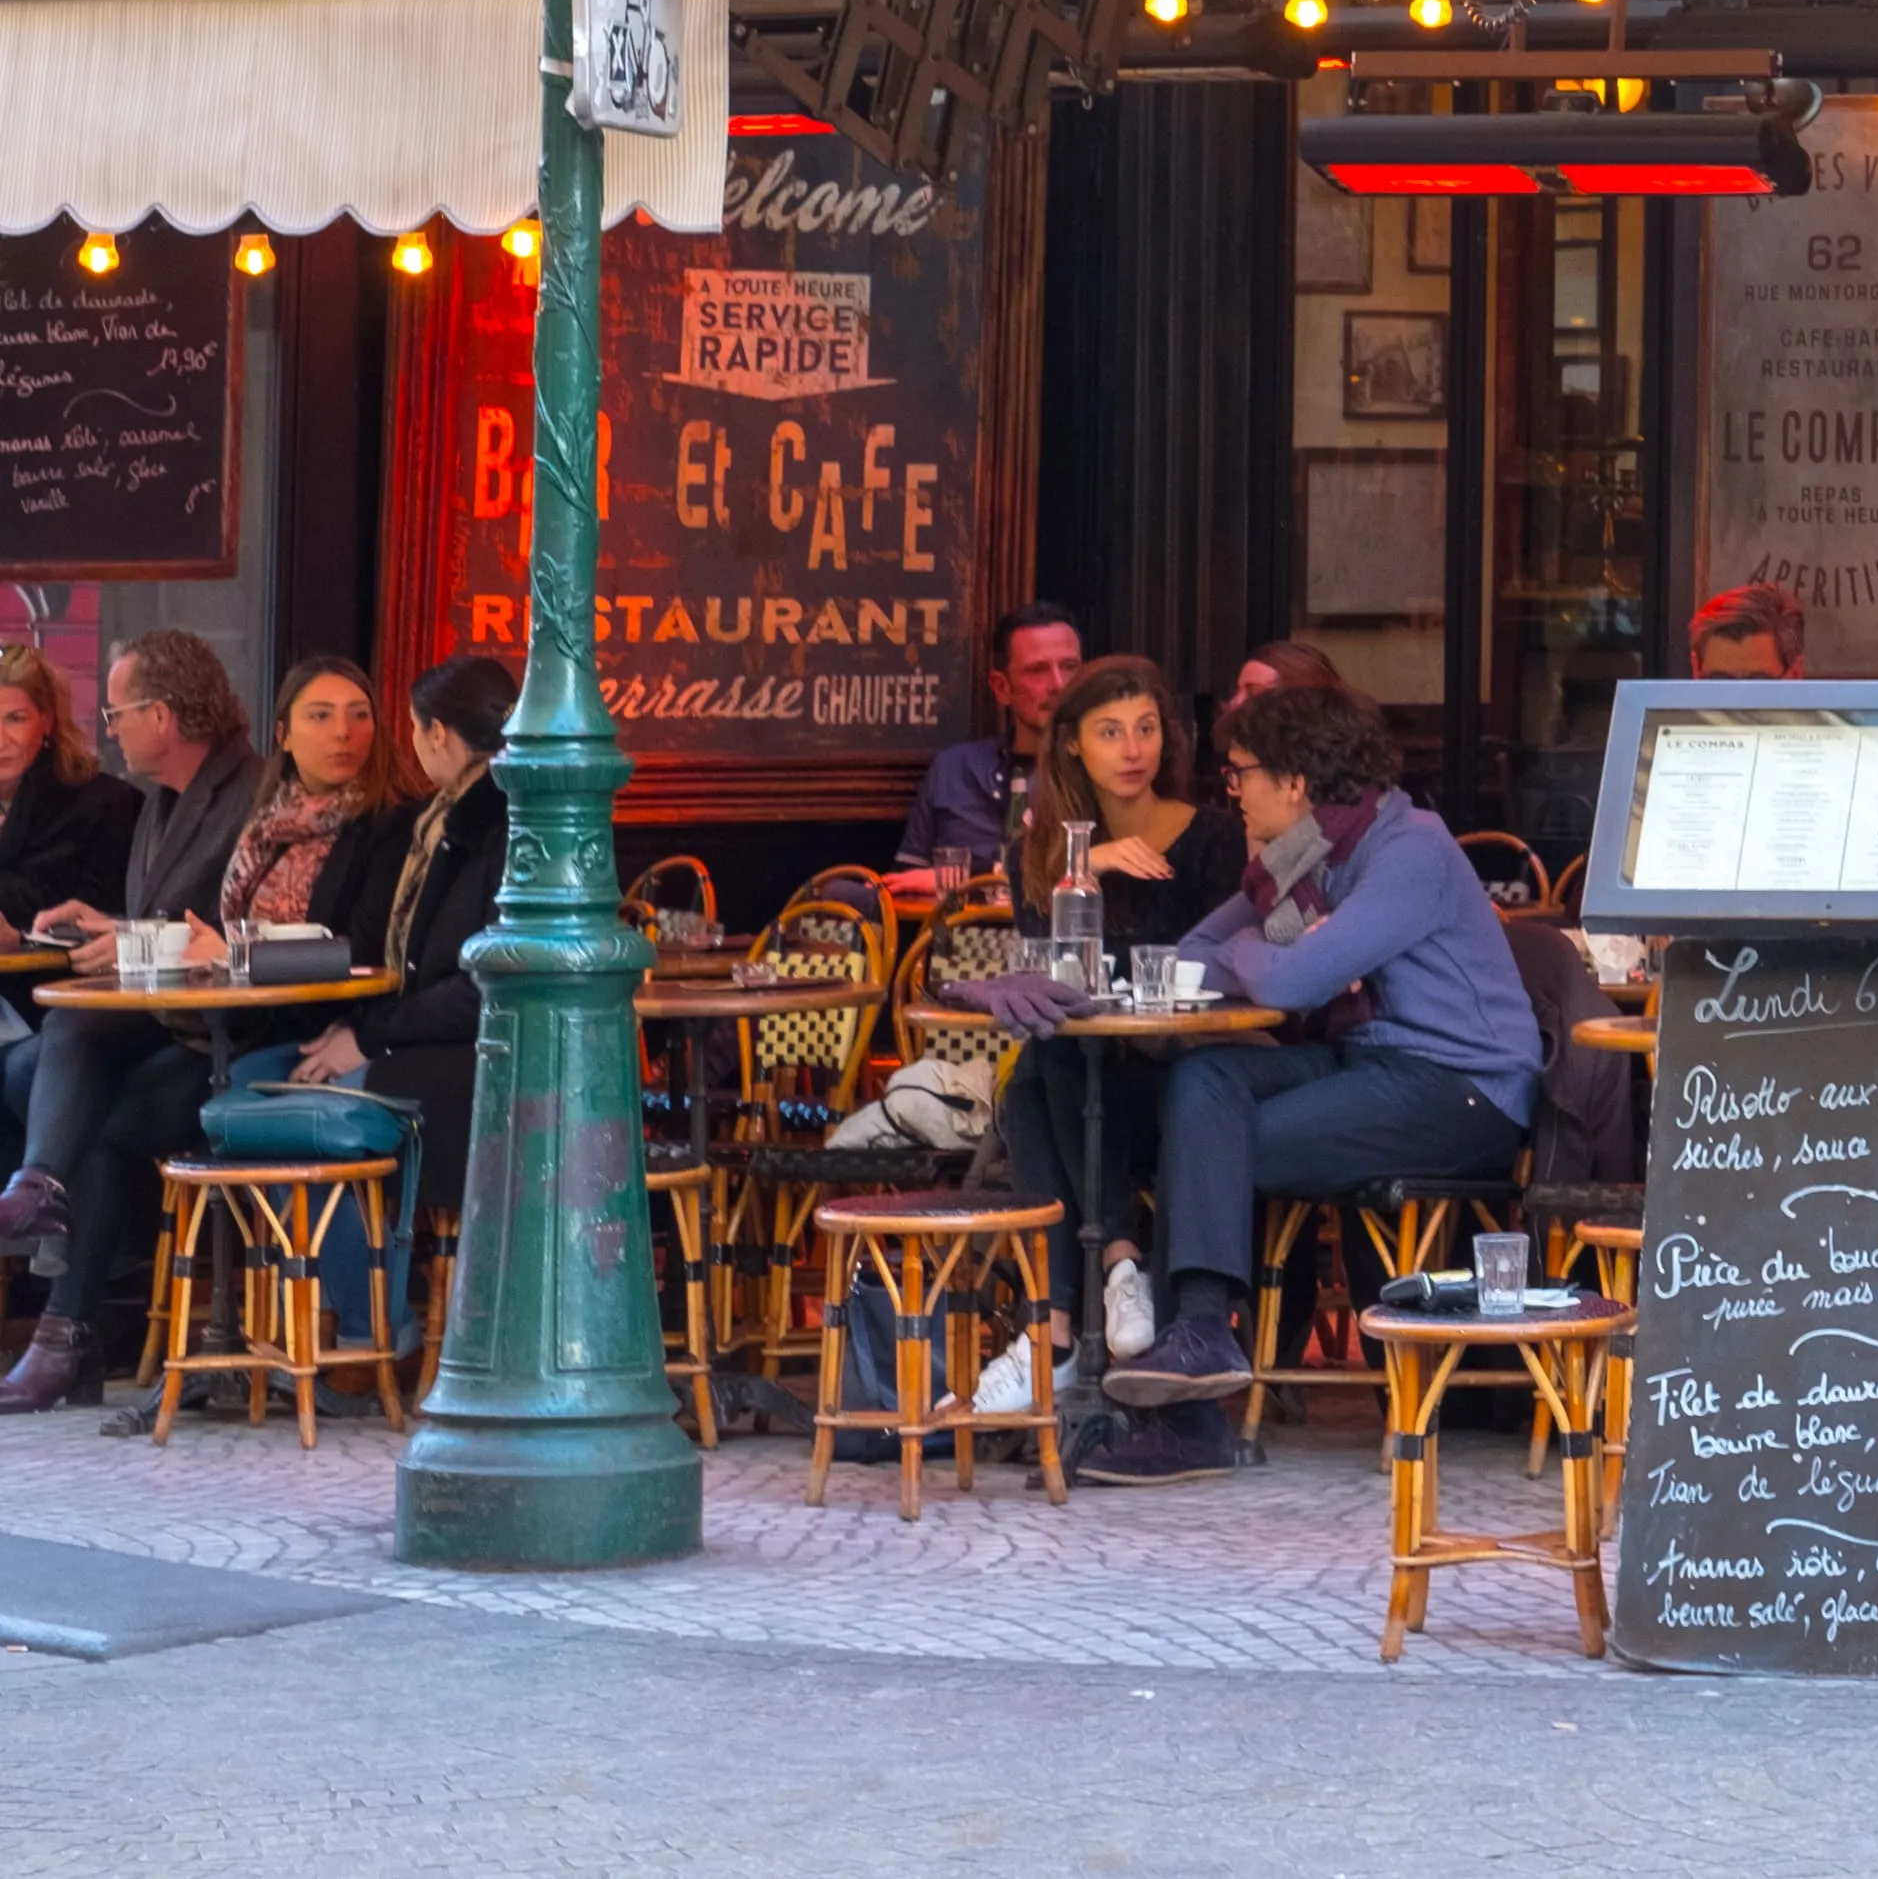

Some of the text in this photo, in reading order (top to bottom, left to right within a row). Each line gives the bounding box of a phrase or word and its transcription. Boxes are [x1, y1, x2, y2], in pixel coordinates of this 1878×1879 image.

[724, 149, 942, 236] elcome
[1807, 234, 1862, 271] 62
[724, 278, 782, 297] TOUTE
[794, 278, 856, 300] HEURE
[1744, 283, 1781, 302] RUE
[700, 301, 854, 333] SERVICE
[700, 335, 852, 373] RAPIDE
[1723, 409, 1767, 464] LE
[768, 419, 939, 573] CAFE
[1776, 505, 1838, 524] TOUTE
[1801, 486, 1862, 505] REPAS
[811, 665, 940, 726] CHAUFFÉE
[1688, 739, 1745, 750] COMPAS
[1694, 946, 1837, 1023] Lundi
[1676, 1064, 1804, 1129] Risotto
[1817, 1076, 1877, 1108] aux
[1653, 1233, 1753, 1300] Pièce
[1761, 1248, 1811, 1281] du
[1646, 1367, 1721, 1427] Filet
[1735, 1374, 1782, 1410] de
[1690, 1424, 1790, 1460] beurre
[1647, 1459, 1713, 1510] Tian
[1738, 1463, 1777, 1502] de
[1646, 1538, 1767, 1586] Ananas
[1657, 1590, 1743, 1629] beurre
